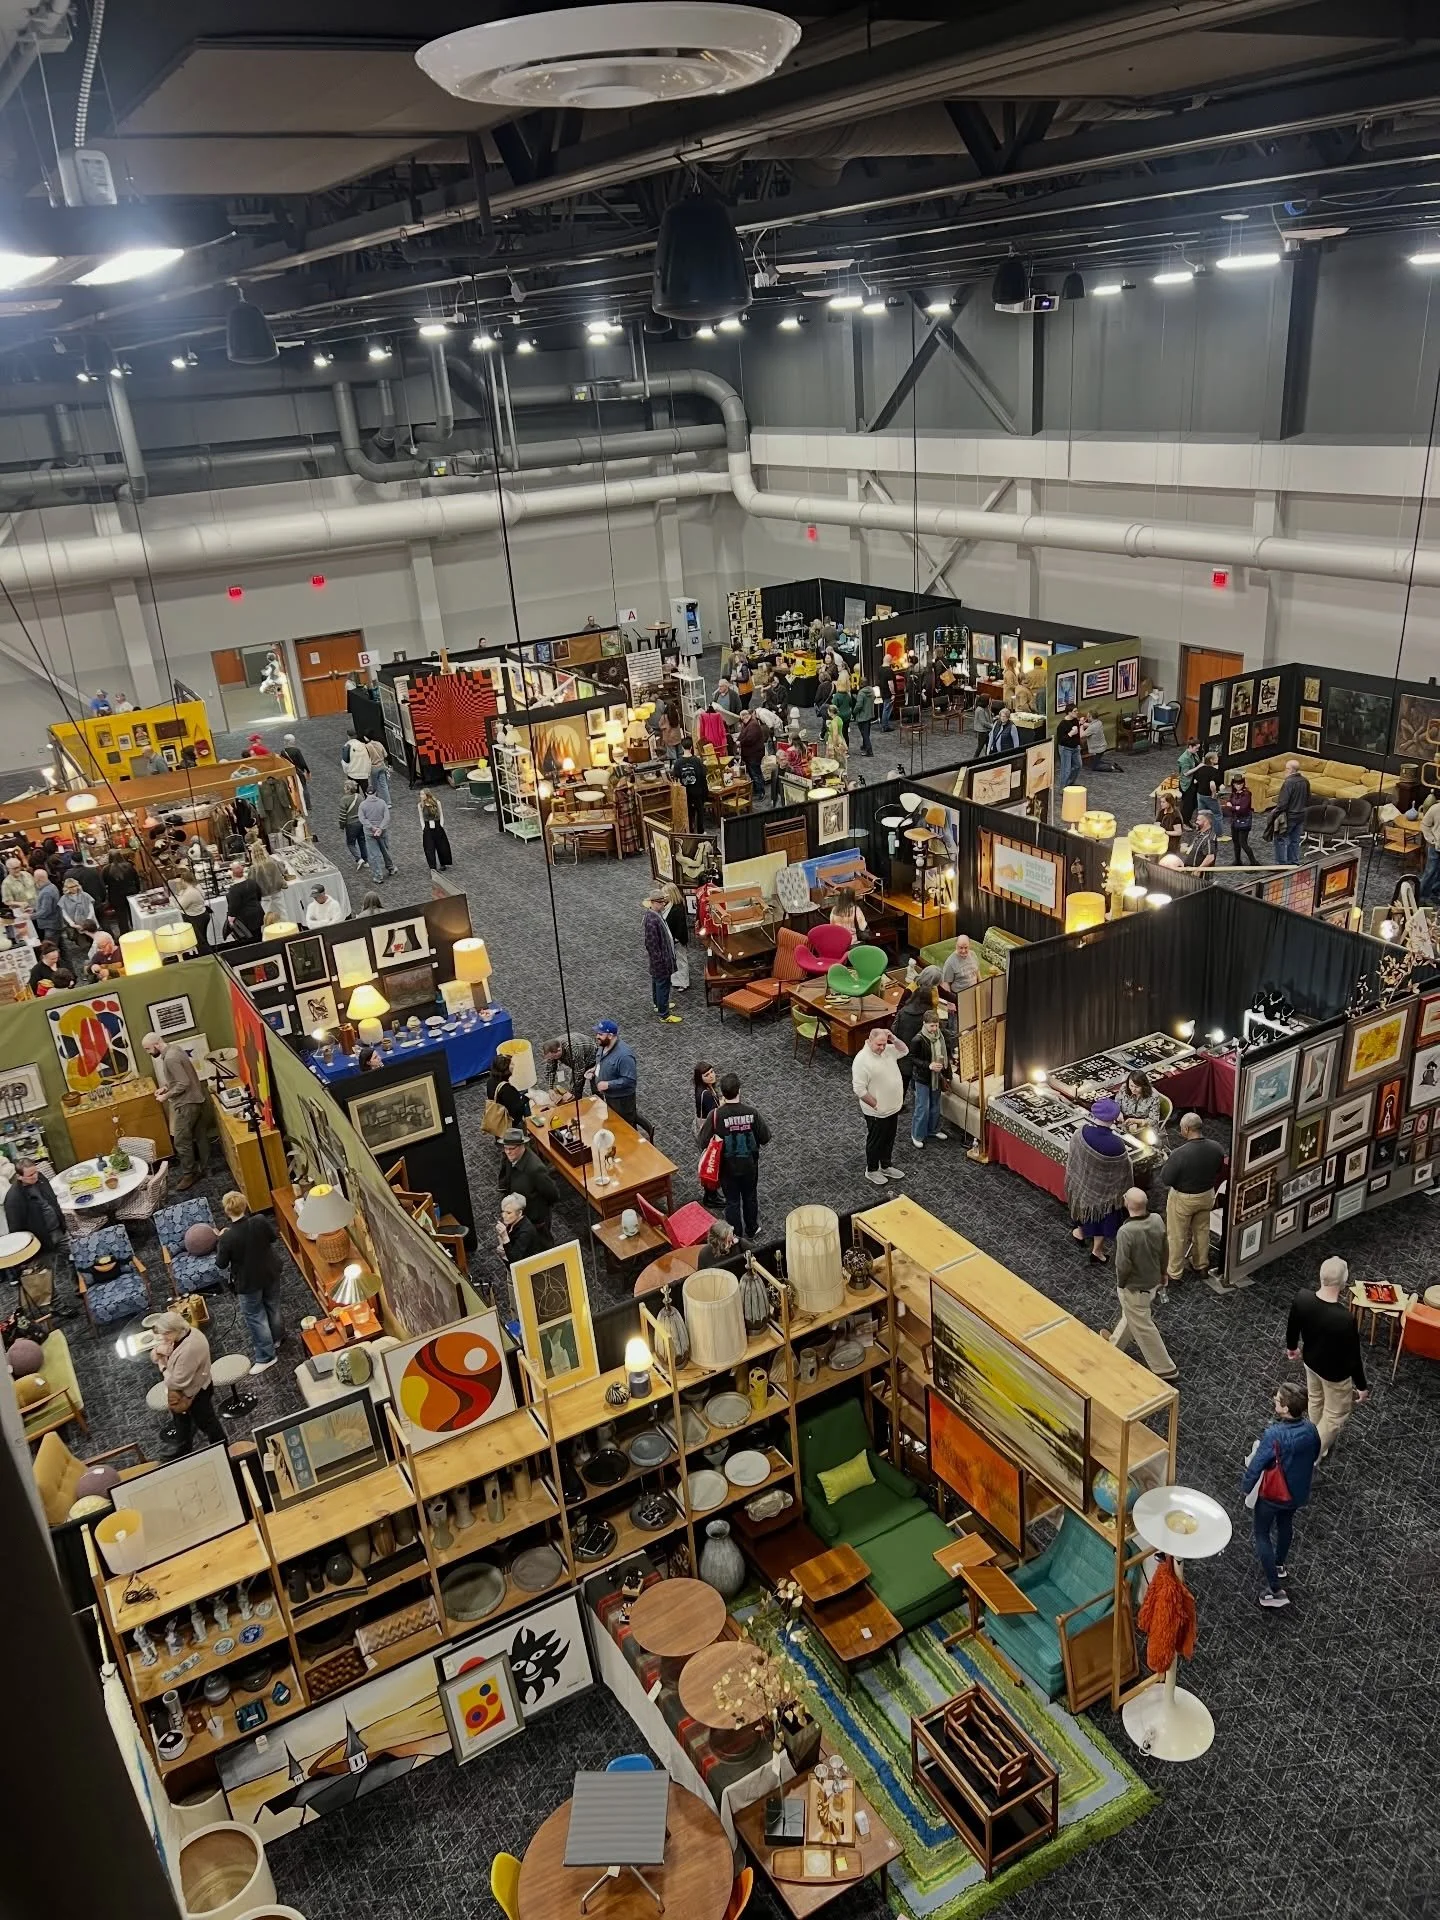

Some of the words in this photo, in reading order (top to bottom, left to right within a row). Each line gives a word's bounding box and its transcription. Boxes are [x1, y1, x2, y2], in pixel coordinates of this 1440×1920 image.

[628, 611, 636, 620] A
[361, 654, 370, 664] B
[1025, 869, 1053, 885] metro
